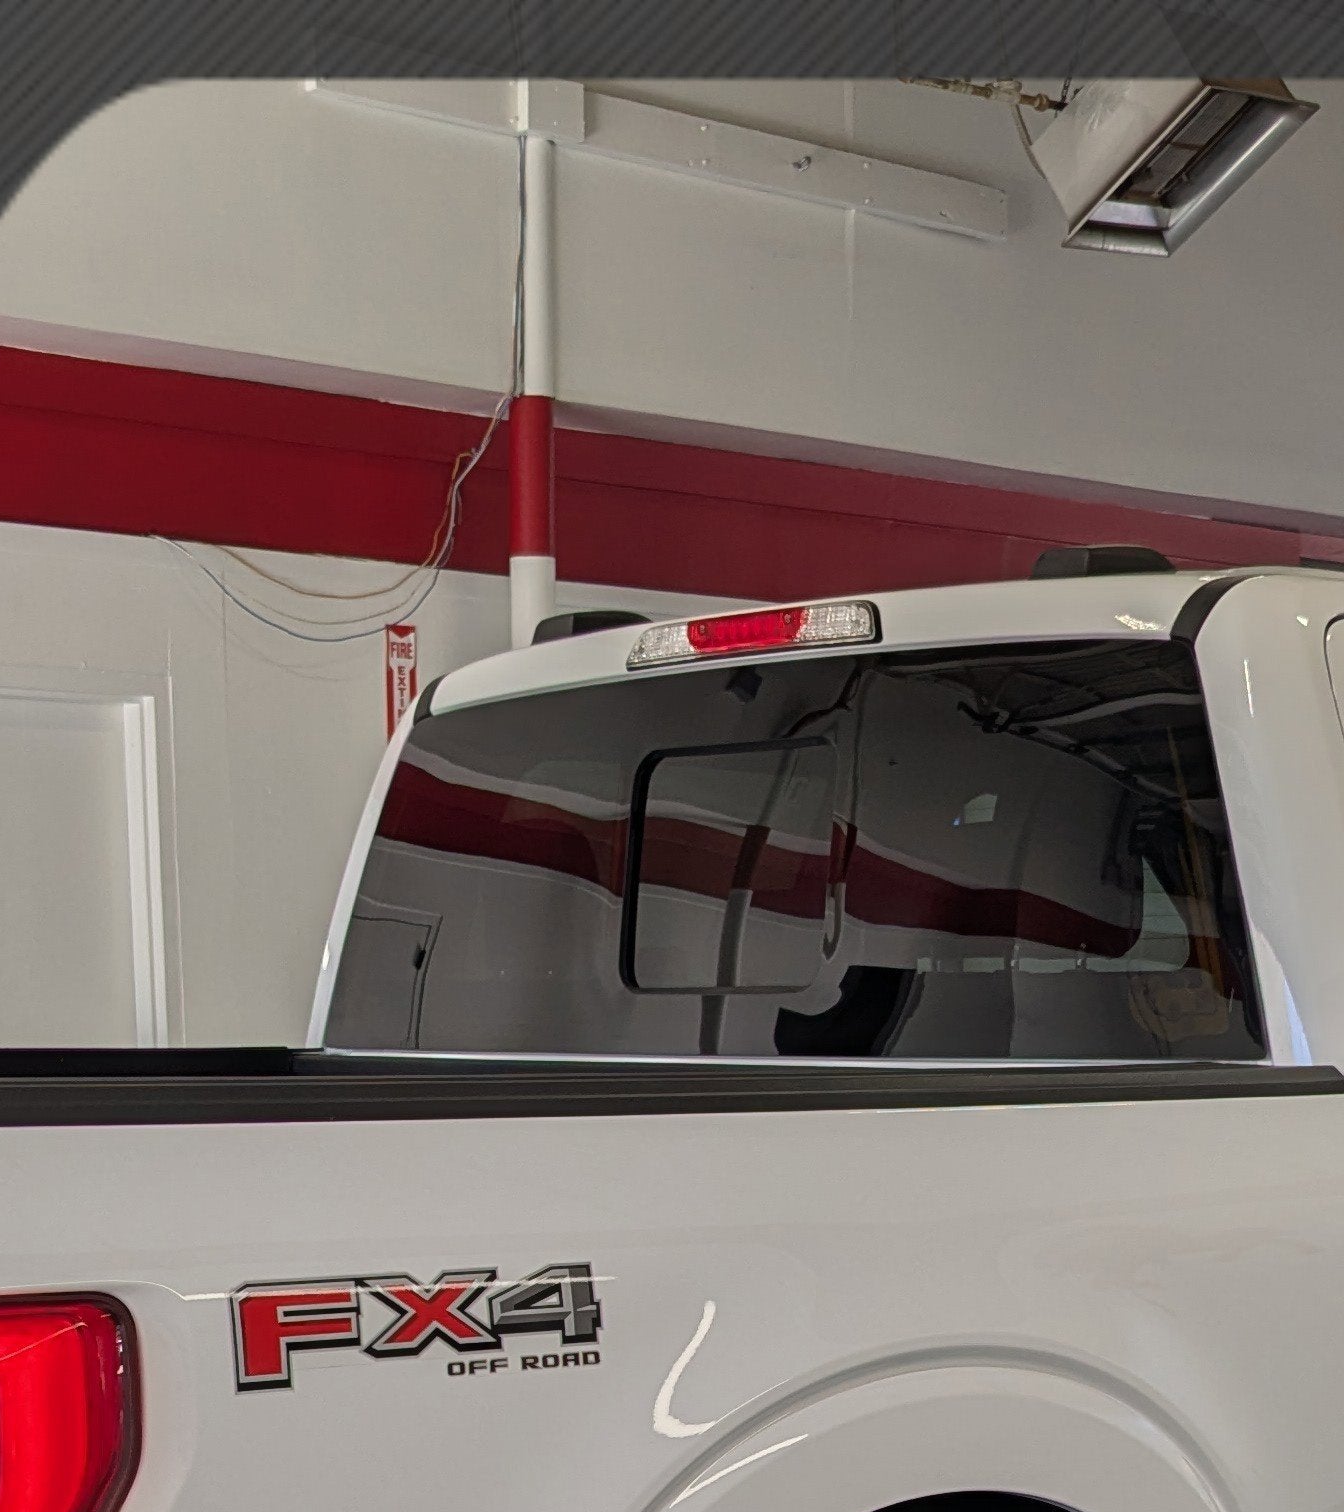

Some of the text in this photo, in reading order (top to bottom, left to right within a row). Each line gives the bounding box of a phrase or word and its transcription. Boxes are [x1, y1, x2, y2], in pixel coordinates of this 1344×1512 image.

[390, 641, 413, 660] FIRE
[231, 1262, 603, 1394] FX4
[447, 1350, 601, 1377] OFF ROAD
